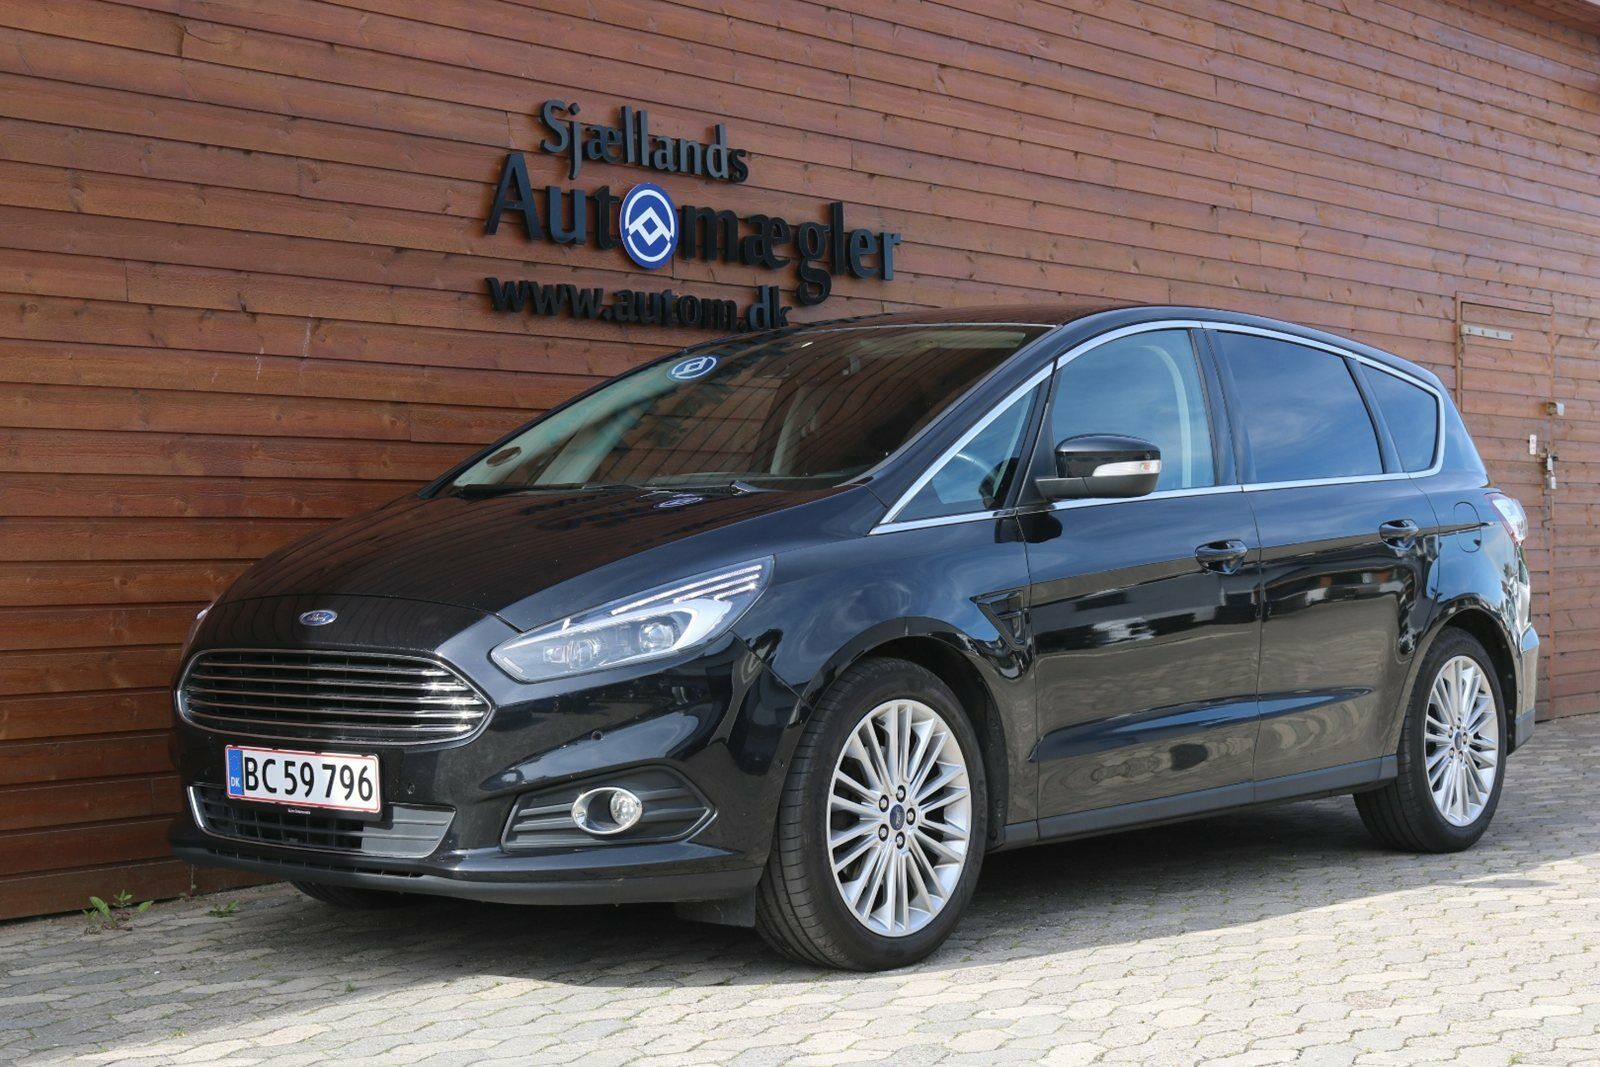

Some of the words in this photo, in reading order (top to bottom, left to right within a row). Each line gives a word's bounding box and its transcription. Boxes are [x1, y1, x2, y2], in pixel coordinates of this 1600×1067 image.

[540, 100, 749, 183] Sjællands
[485, 277, 792, 331] www.autom.dk
[230, 777, 241, 787] DK
[244, 757, 278, 793] BC
[322, 763, 373, 801] 796
